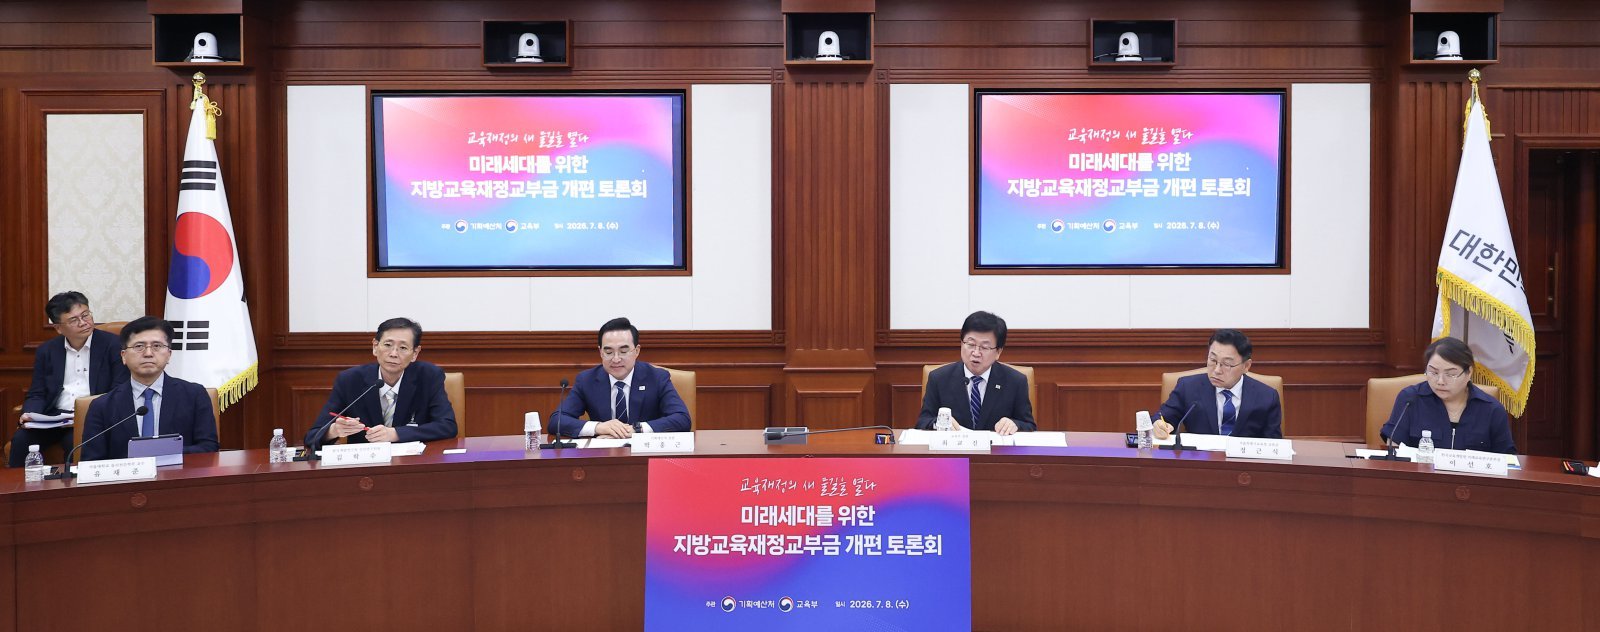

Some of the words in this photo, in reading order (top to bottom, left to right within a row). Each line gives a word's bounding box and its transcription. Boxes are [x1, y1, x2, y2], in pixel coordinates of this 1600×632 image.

[468, 132, 519, 147] 교육재정의
[523, 133, 534, 145] 새
[568, 131, 589, 148] 열다
[1068, 128, 1120, 144] 교육재정의
[1126, 130, 1136, 142] 새
[1171, 128, 1193, 145] 열다
[469, 156, 551, 174] 미래세대를
[554, 156, 588, 174] 위한
[1069, 152, 1154, 172] 미래세대를
[1157, 152, 1191, 172] 위한
[410, 180, 558, 198] 지방교육재정교부금
[562, 180, 594, 198] 개편
[598, 180, 647, 198] 토론회
[1007, 178, 1159, 197] 지방교육재정교부금
[1163, 178, 1196, 197] 개편
[1200, 178, 1250, 197] 토론회
[1119, 222, 1138, 230] 교육부
[1190, 222, 1197, 230] 7.
[1207, 222, 1220, 230] (수)
[1448, 229, 1524, 290] 대한민
[740, 477, 797, 495] 교육재정의
[803, 480, 814, 492] 새
[852, 477, 877, 496] 열다
[741, 505, 834, 526] 미래세대를
[838, 505, 875, 526] 위한
[673, 534, 840, 556] 지방교육재정교부금
[845, 534, 881, 556] 개편
[886, 534, 942, 556] 토론회
[738, 600, 775, 609] 기획예산처
[796, 600, 818, 609] 교육부
[850, 600, 874, 609] 2026.
[875, 600, 883, 609] 7.
[885, 600, 893, 609] 8.
[895, 600, 910, 609] (수)
